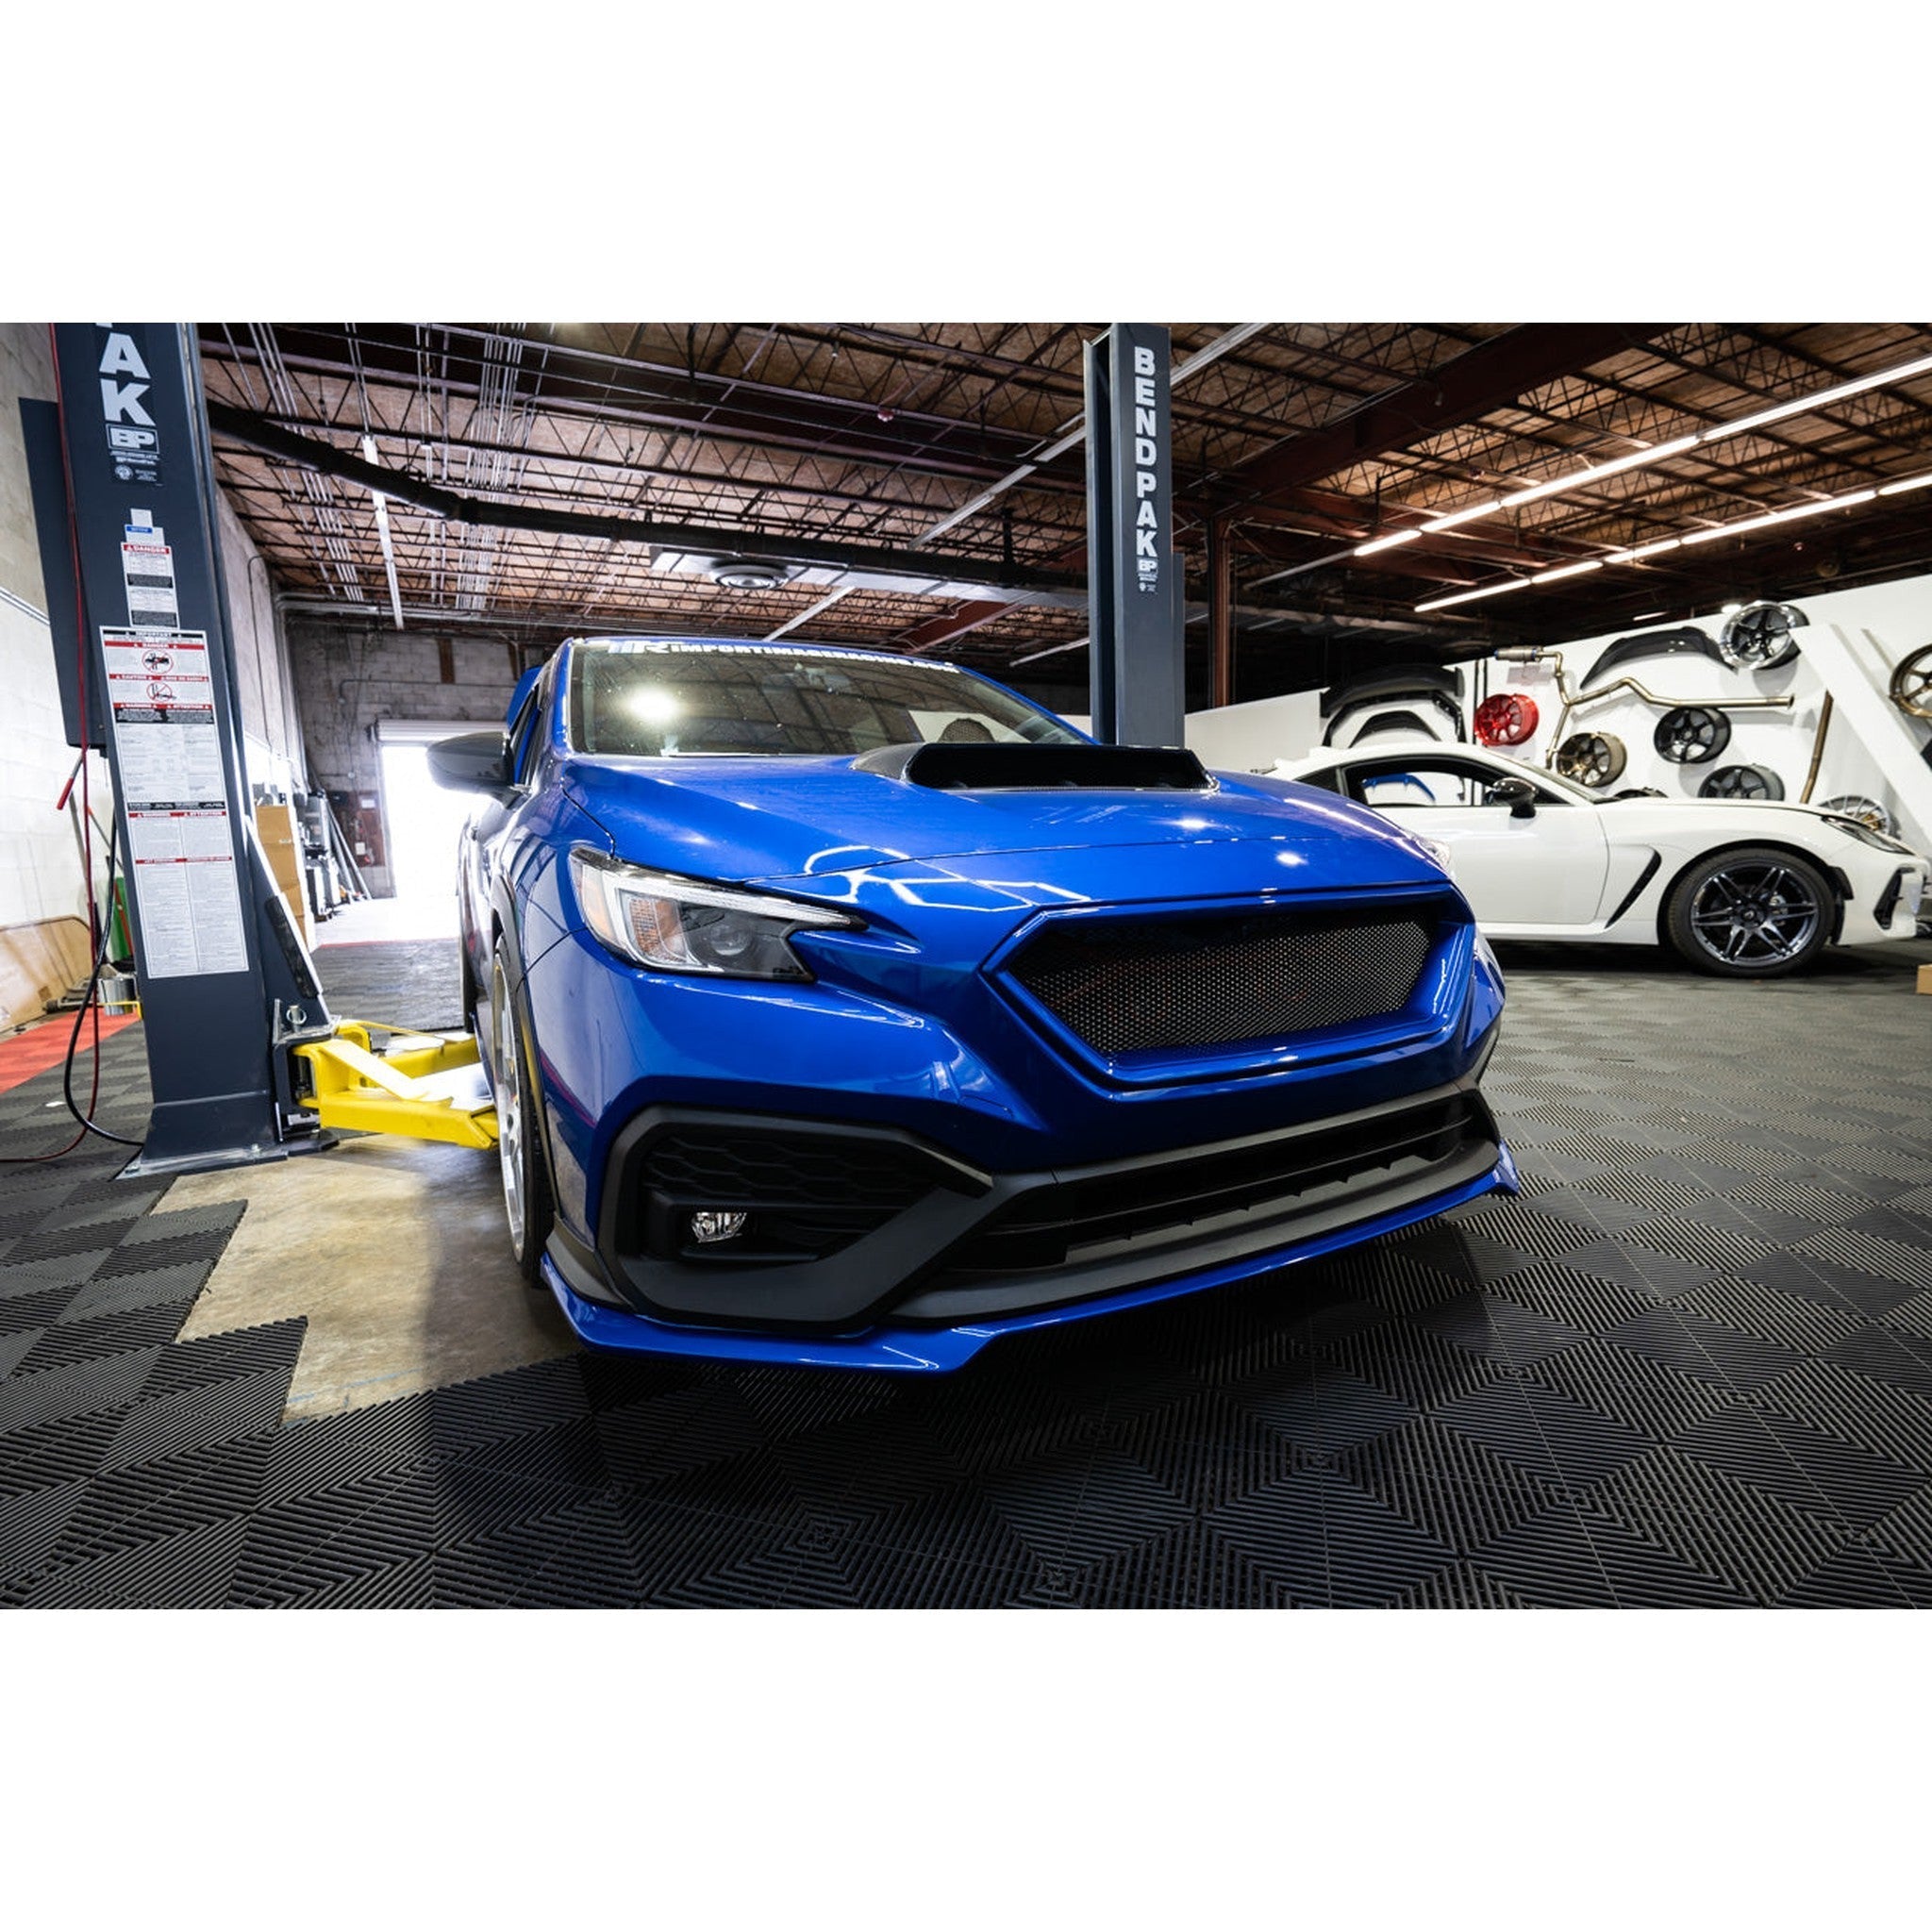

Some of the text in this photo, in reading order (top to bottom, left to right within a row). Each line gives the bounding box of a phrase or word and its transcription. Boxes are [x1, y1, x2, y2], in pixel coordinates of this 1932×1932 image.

[96, 323, 157, 426] AK
[108, 427, 156, 449] BP
[1134, 345, 1158, 558] BENDPAK
